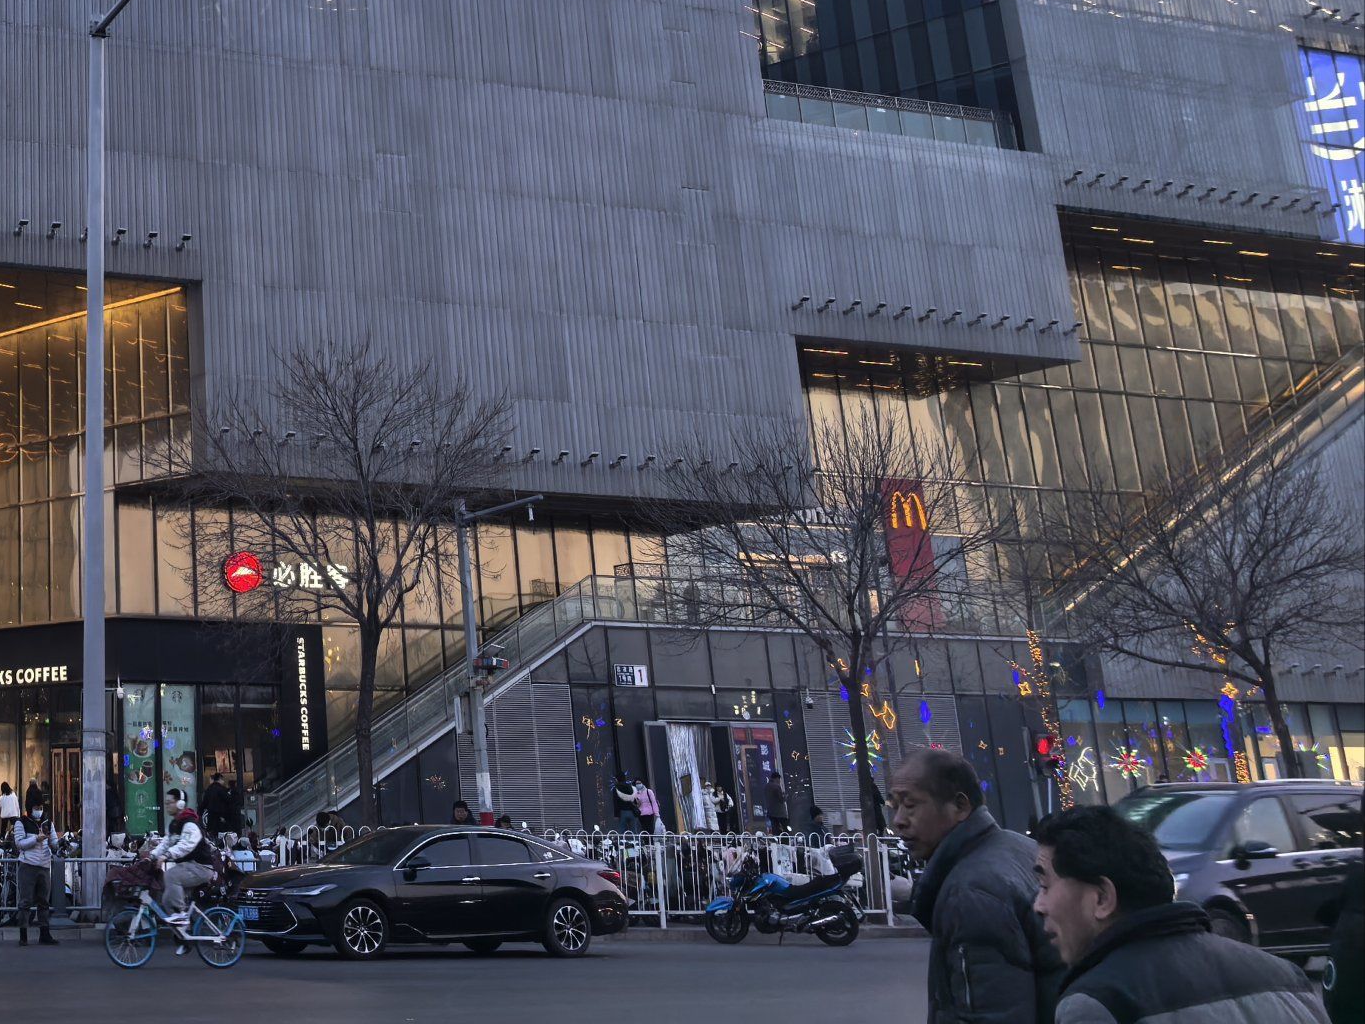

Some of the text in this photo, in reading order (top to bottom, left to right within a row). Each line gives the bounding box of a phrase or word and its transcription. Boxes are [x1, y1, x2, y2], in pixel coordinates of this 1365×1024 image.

[16, 665, 68, 685] COFFEE
[296, 637, 310, 751] STARBUCKS COFFEE
